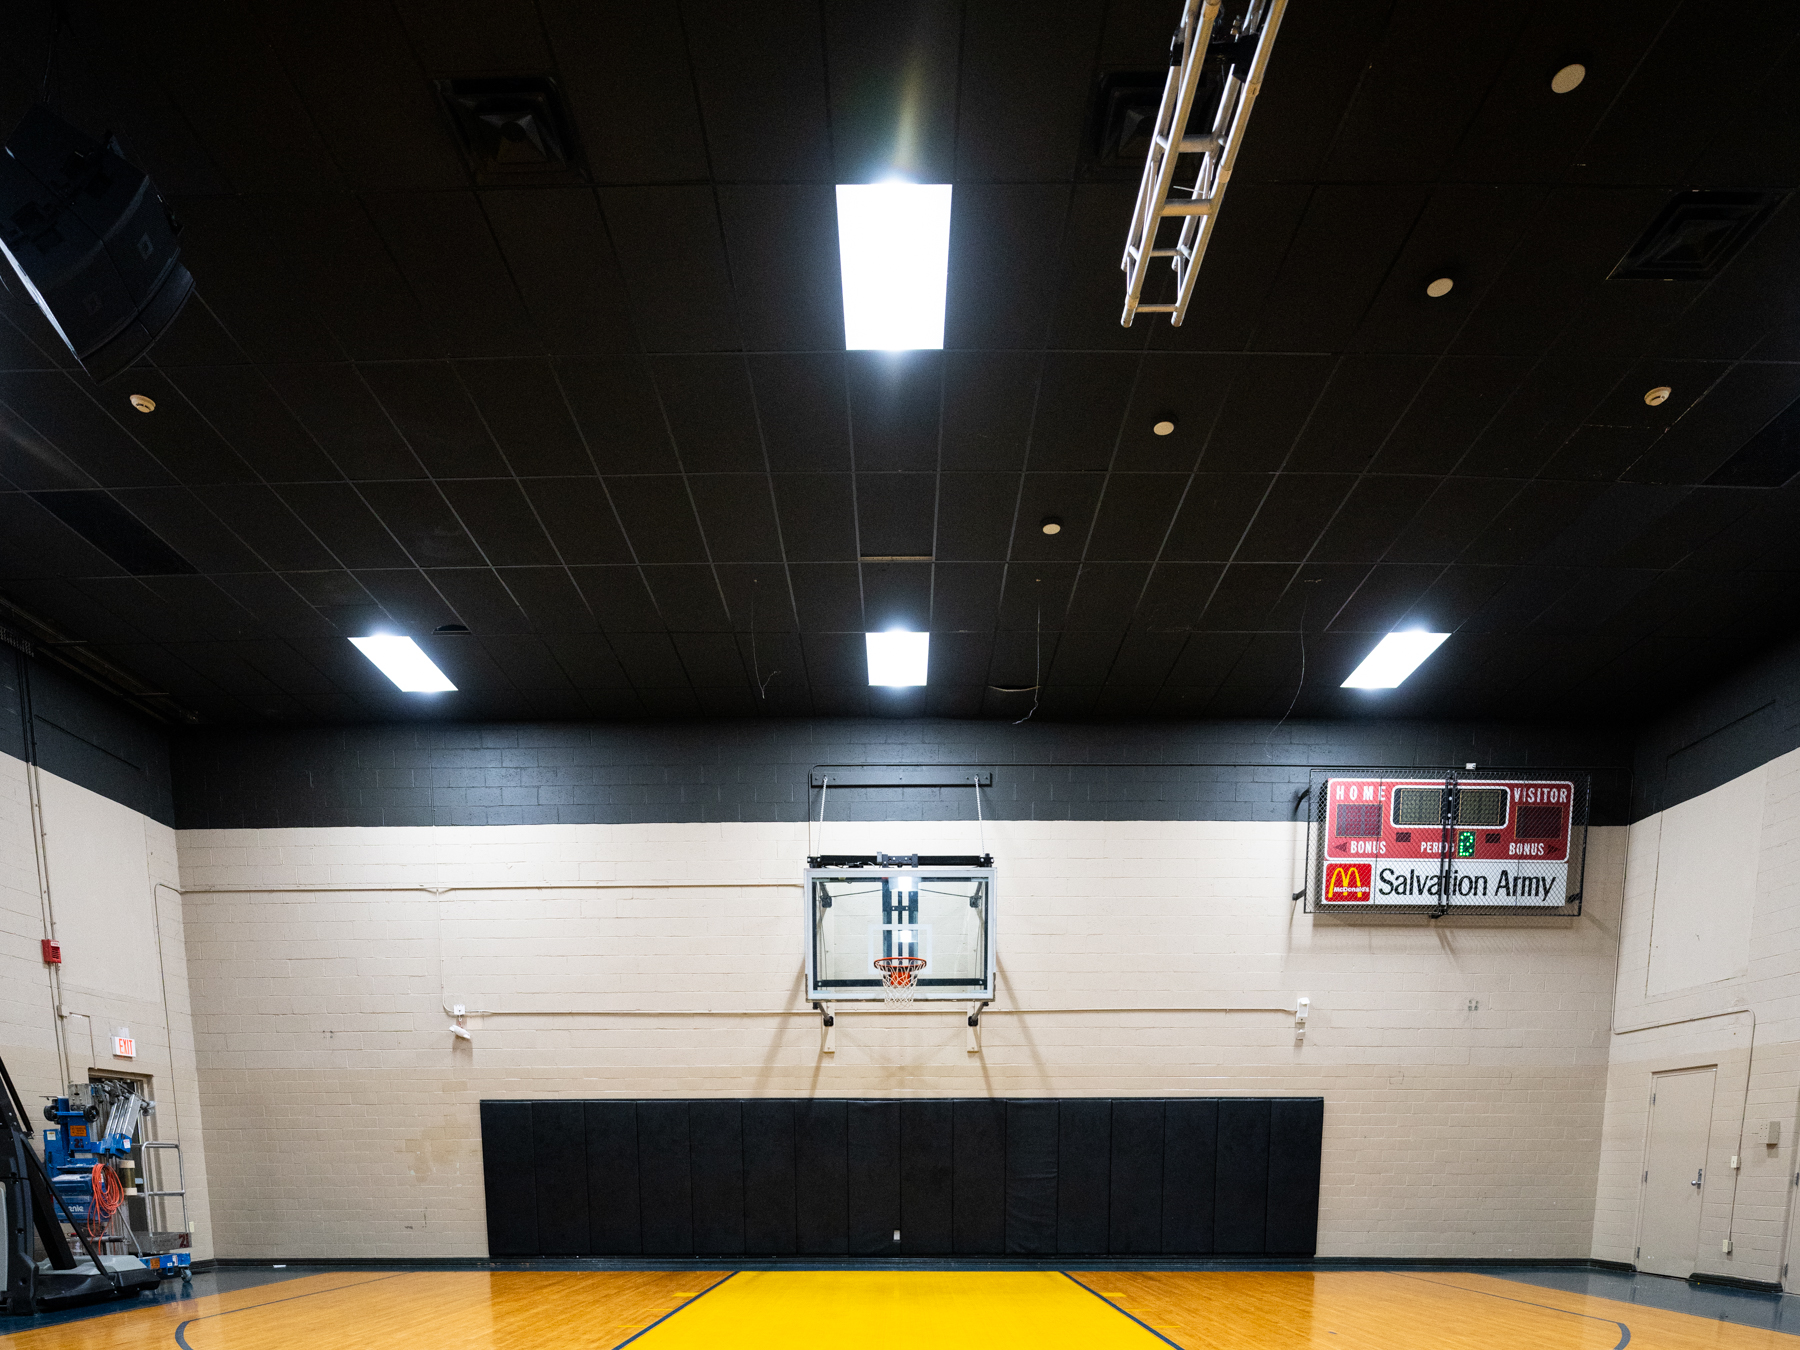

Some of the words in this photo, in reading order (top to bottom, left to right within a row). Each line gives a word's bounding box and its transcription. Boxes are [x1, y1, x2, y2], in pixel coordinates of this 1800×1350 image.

[1335, 785, 1388, 801] HOME
[1514, 788, 1568, 804] VISITOR
[1350, 841, 1387, 854] BONUS
[1508, 843, 1545, 856] BONUS
[1378, 868, 1488, 897] Salvation
[1495, 869, 1557, 902] Army
[118, 1038, 133, 1055] EXIT
[178, 1233, 190, 1248] 21
